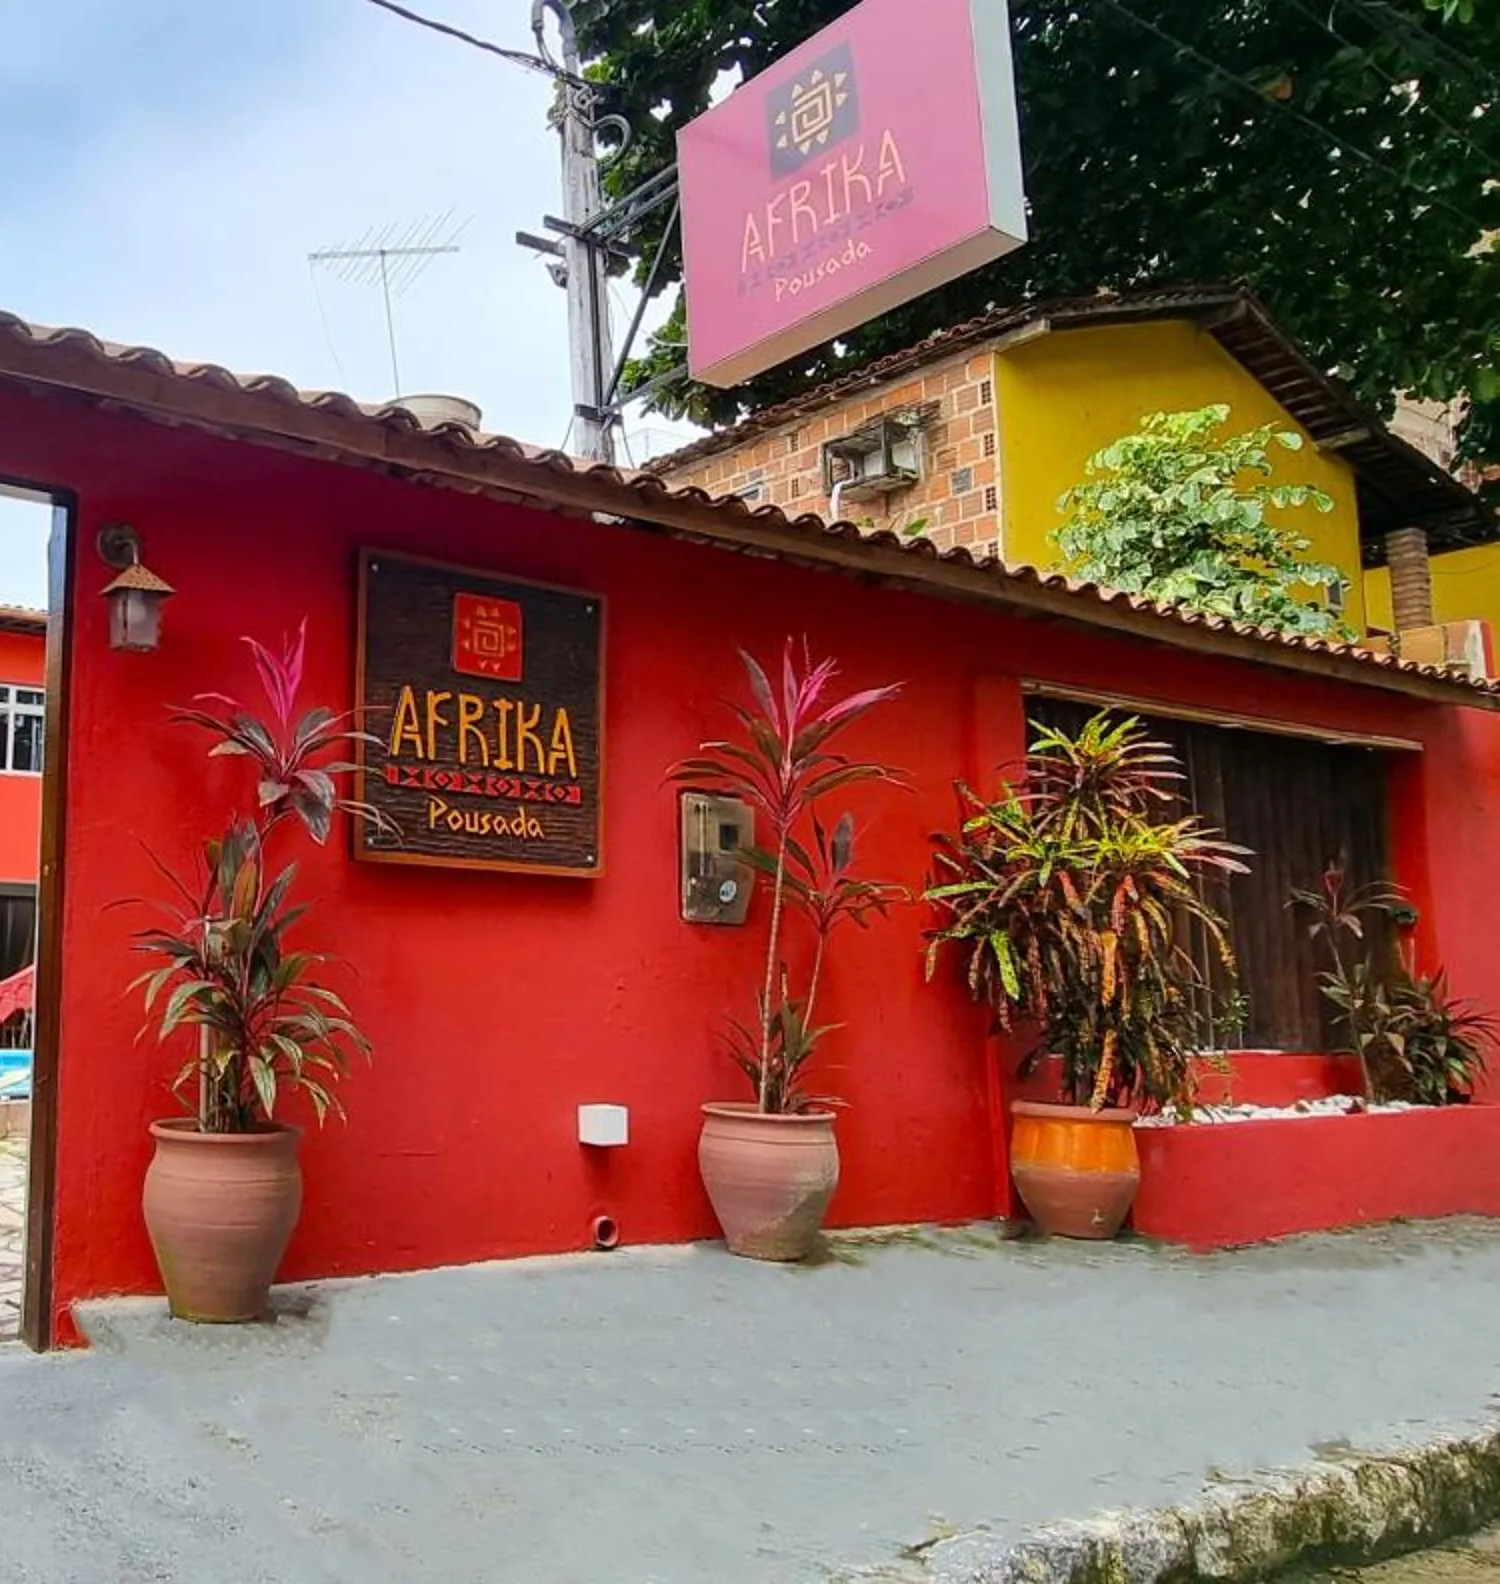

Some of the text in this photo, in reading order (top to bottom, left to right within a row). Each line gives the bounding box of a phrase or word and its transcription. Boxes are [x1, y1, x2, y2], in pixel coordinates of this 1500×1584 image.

[740, 129, 906, 274] AFRIKA
[773, 239, 873, 302] Pousada
[390, 685, 578, 778] AFRIKA
[428, 795, 545, 839] Pousada
